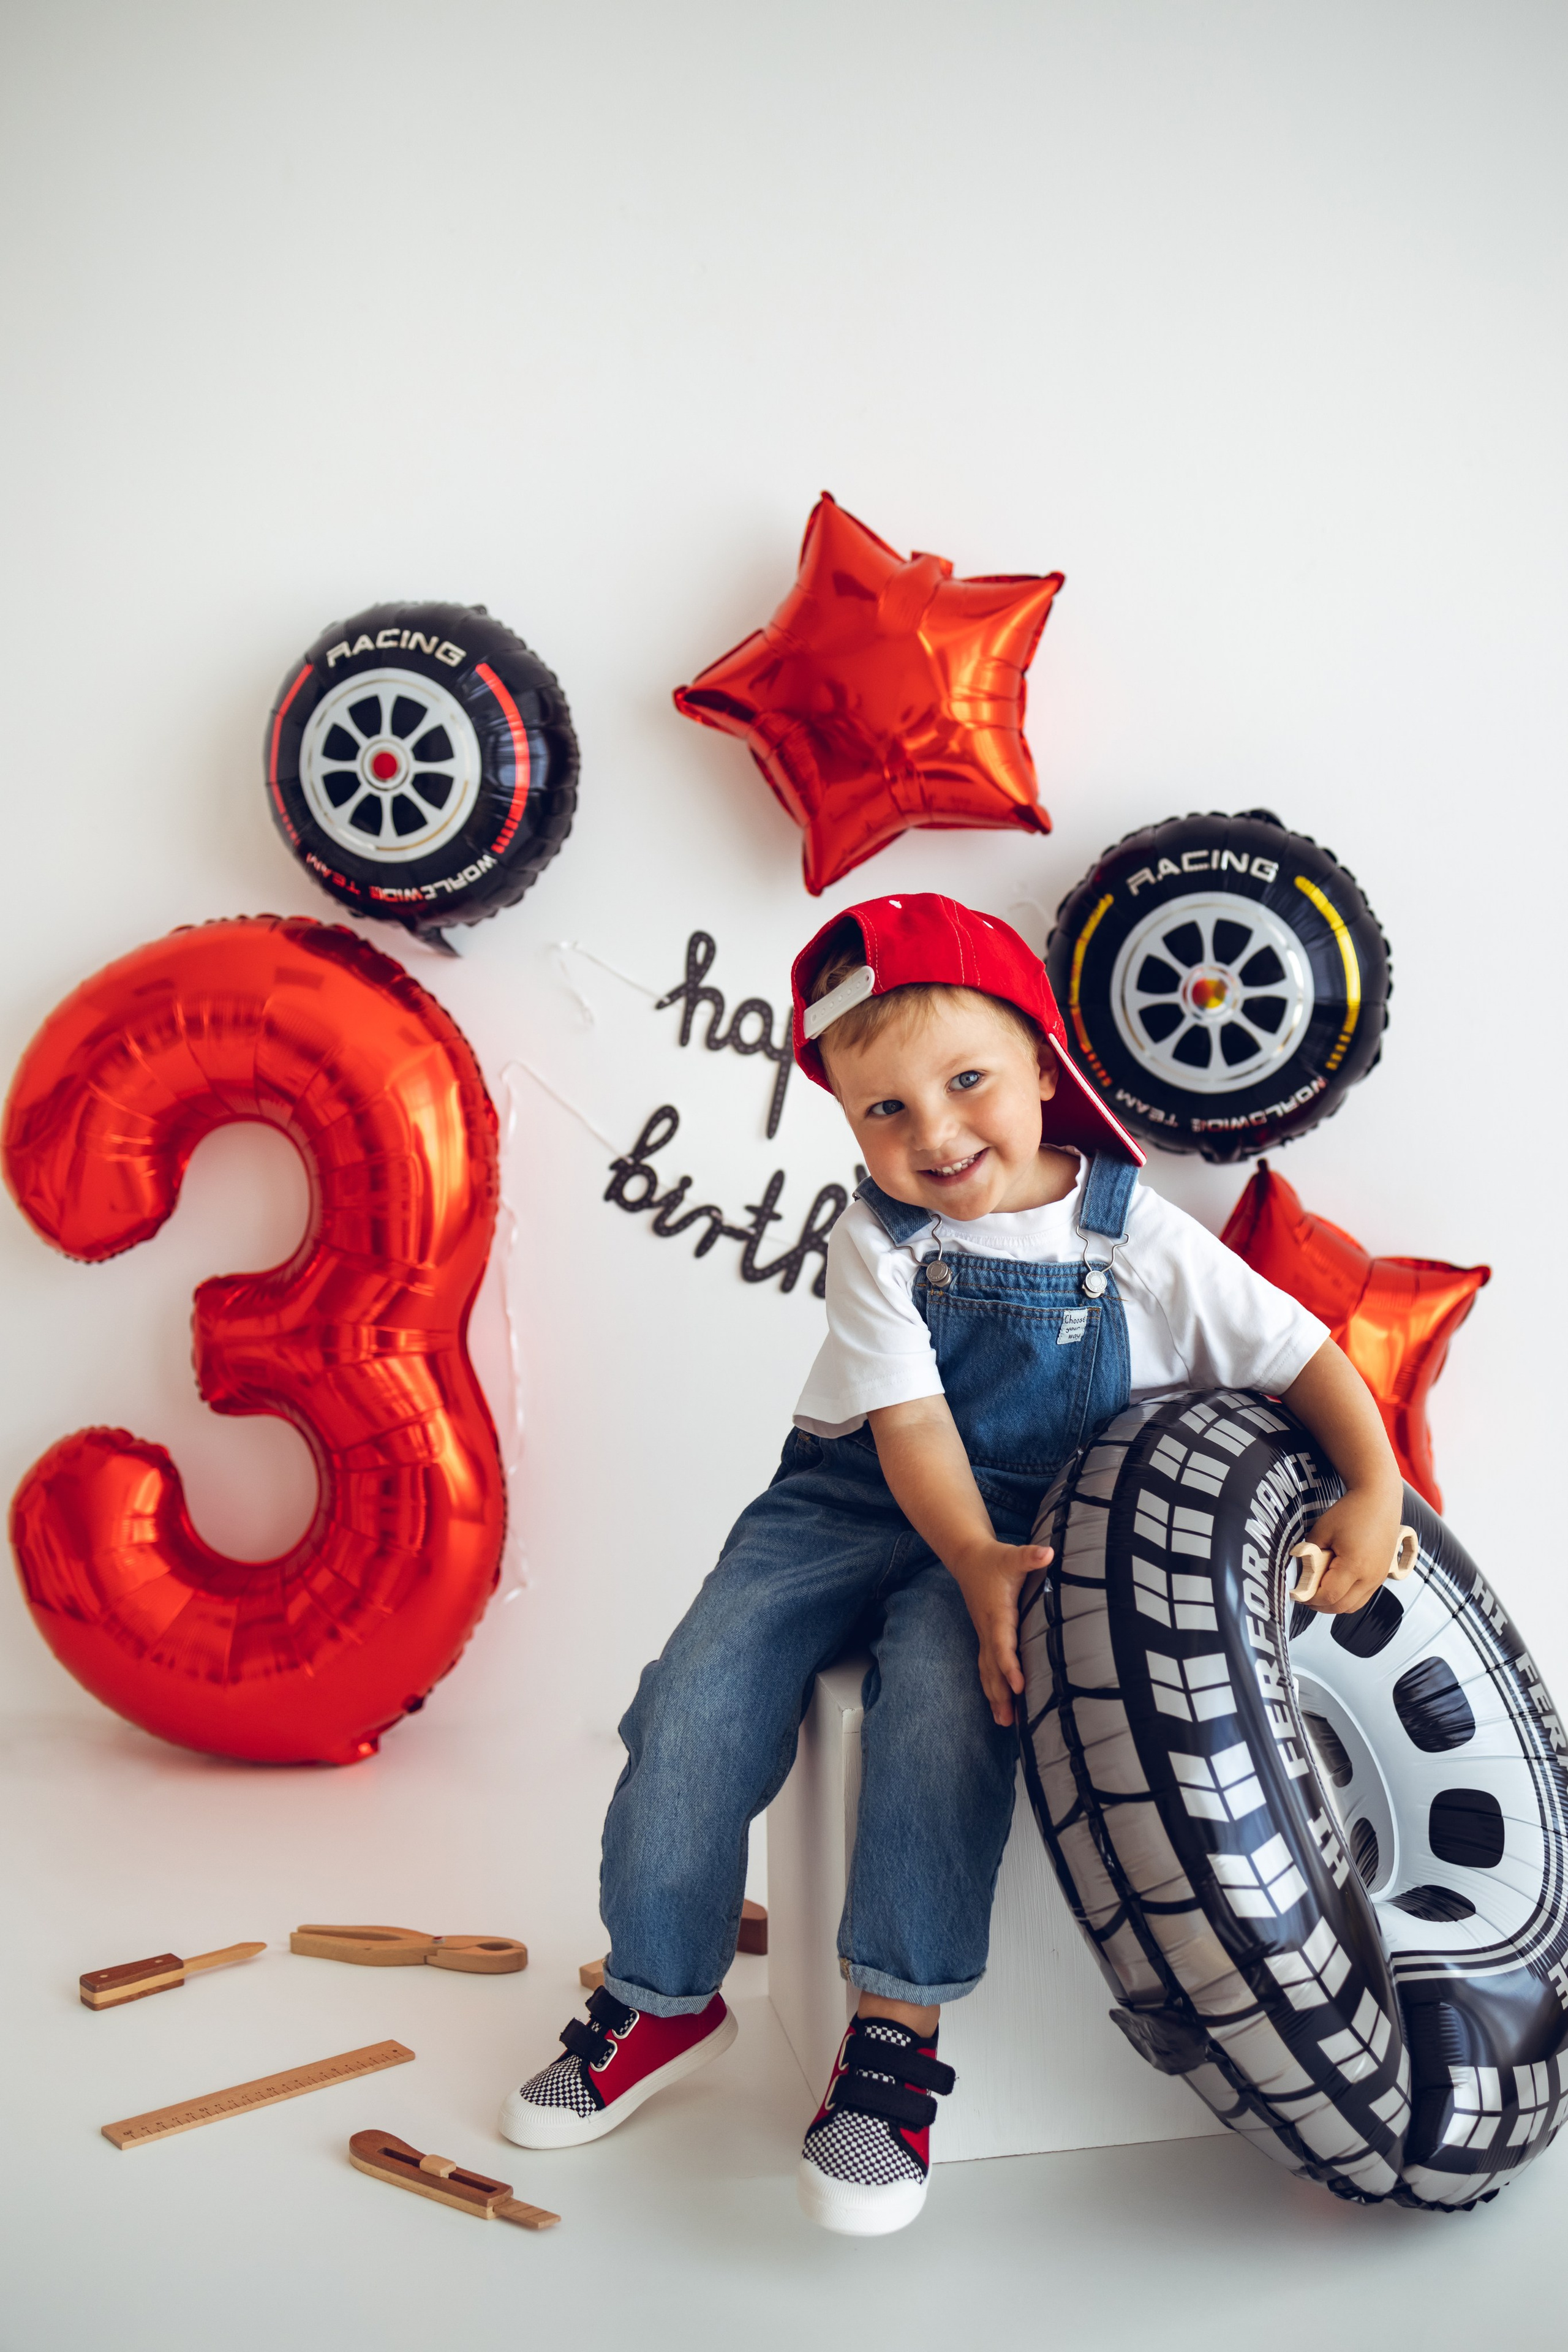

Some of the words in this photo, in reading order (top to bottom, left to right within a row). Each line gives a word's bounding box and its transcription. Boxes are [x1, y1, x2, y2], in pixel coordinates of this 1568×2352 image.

[326, 628, 467, 668] RACING
[306, 852, 361, 895] TEAM
[1126, 849, 1280, 896] RACING
[1115, 1088, 1179, 1128] TEAM
[1191, 1076, 1329, 1133] WORLDWIDE
[603, 1104, 858, 1299] birth
[1, 914, 507, 1766] 3
[1064, 1314, 1086, 1324] Choose
[1470, 1572, 1509, 1637] HI
[1306, 1806, 1351, 1890] HI
